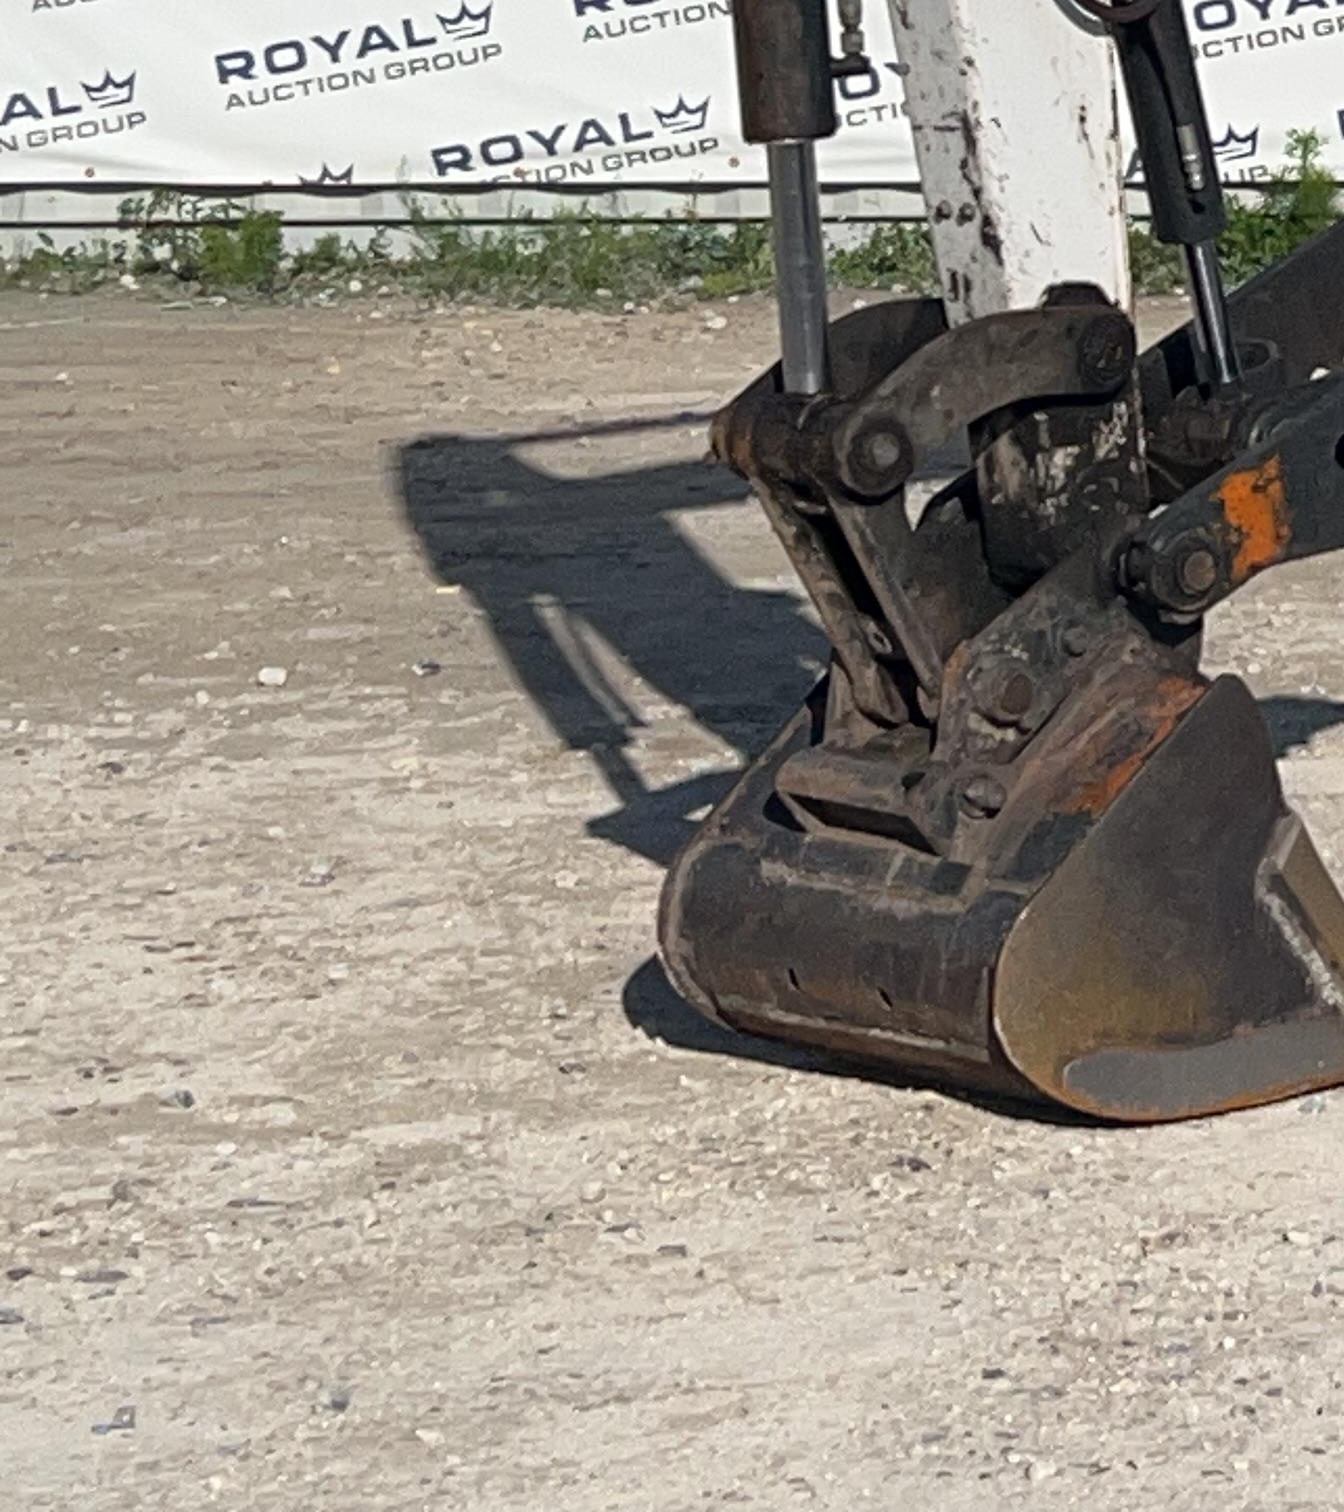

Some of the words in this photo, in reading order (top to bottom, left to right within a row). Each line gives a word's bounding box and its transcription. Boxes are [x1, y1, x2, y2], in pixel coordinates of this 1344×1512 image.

[214, 18, 438, 85] ROYAL
[225, 67, 377, 111] AUCTION
[383, 43, 503, 81] GROUP
[25, 111, 147, 149] GROUP
[429, 112, 655, 178] ROYAL
[600, 136, 720, 172] GROUP
